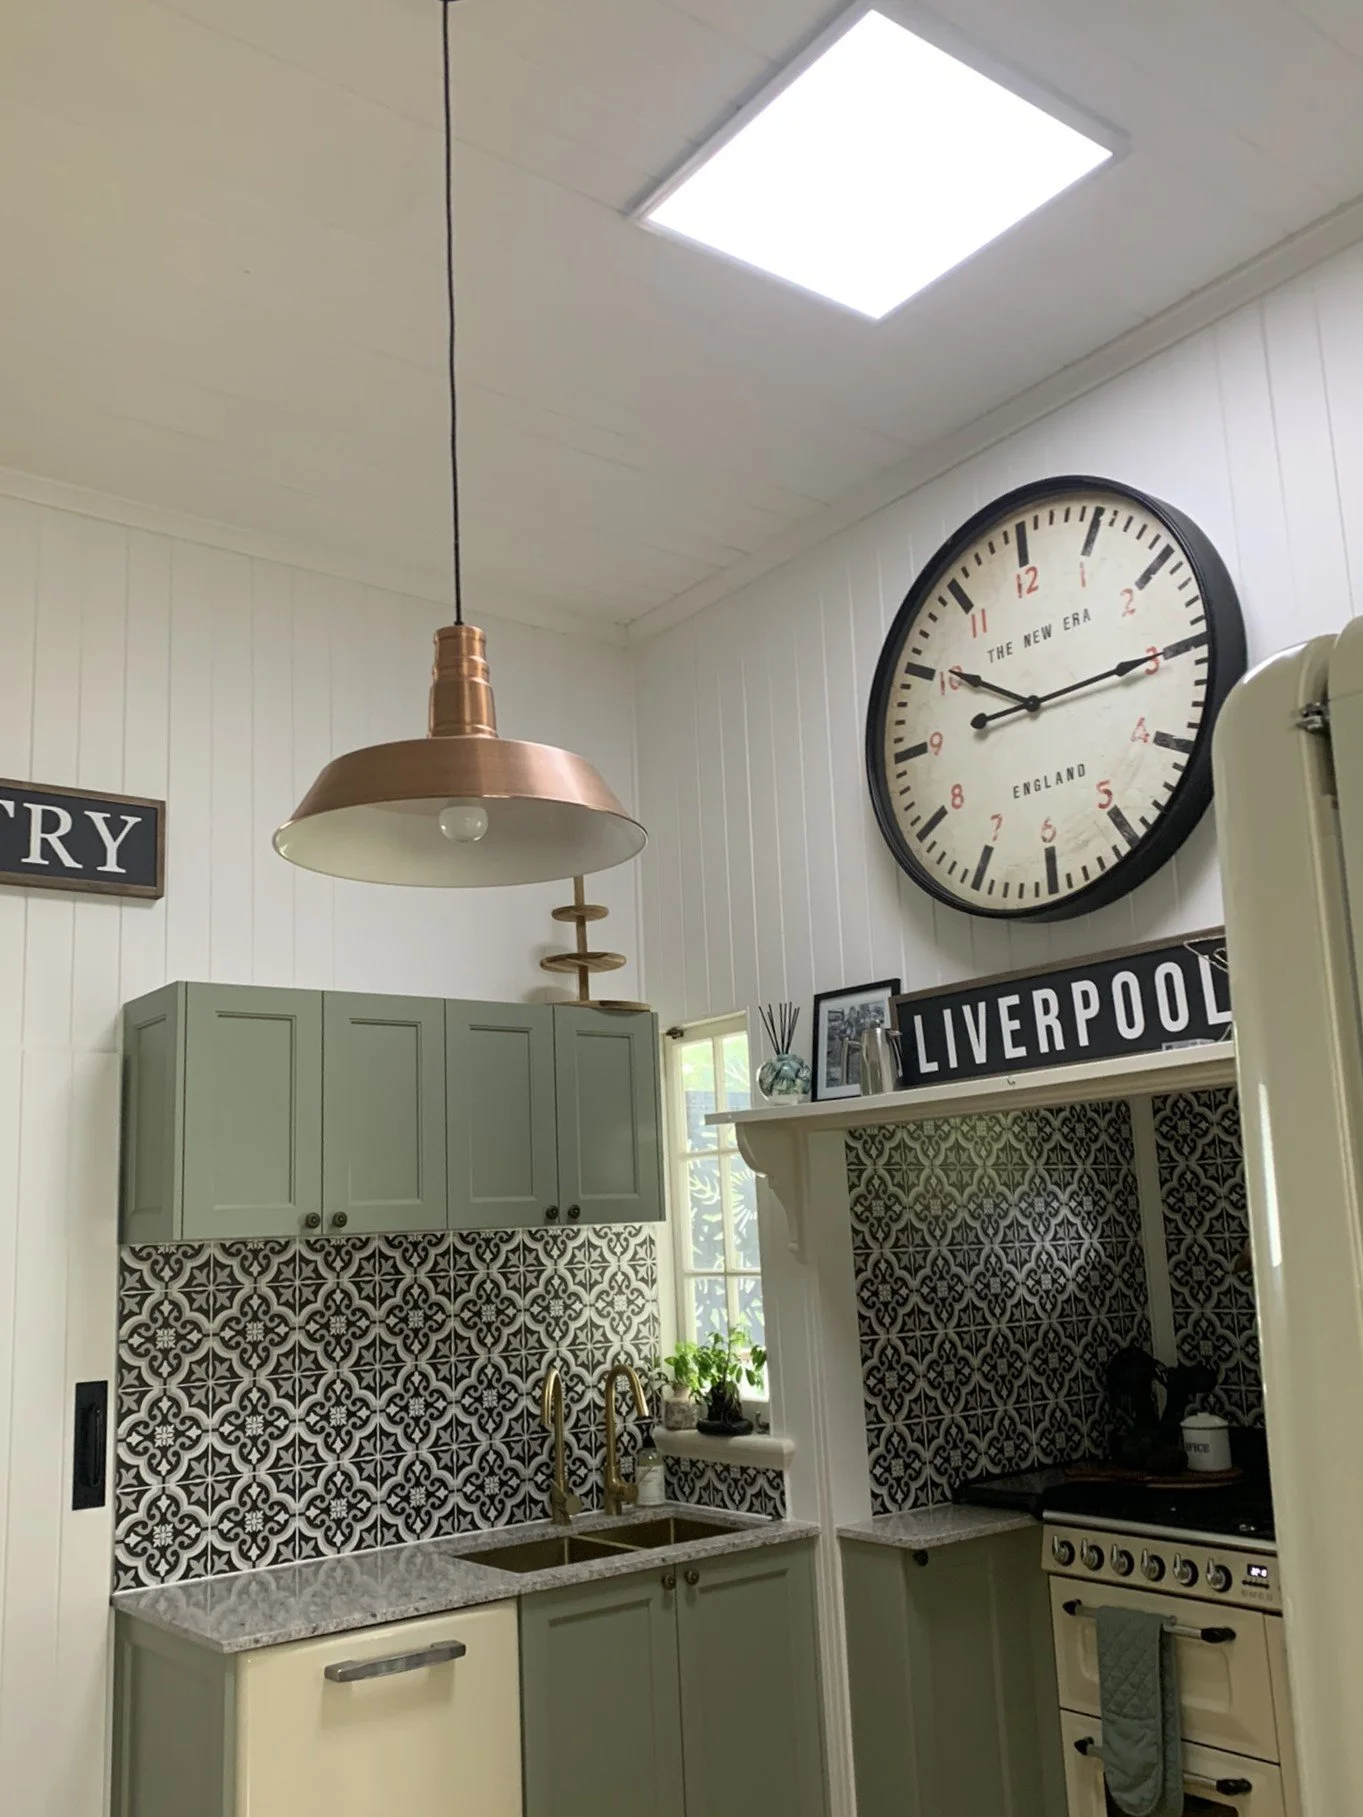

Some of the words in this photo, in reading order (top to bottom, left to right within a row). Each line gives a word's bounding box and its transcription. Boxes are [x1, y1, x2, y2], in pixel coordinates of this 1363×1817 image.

[1016, 566, 1039, 599] 12
[1079, 561, 1086, 588] 1
[1120, 588, 1136, 617] 2
[971, 608, 988, 638] 11
[987, 641, 1014, 663] THE
[1023, 623, 1052, 648] NEW
[1063, 608, 1091, 631] ERA
[1145, 646, 1159, 676] 3
[930, 732, 943, 756] 9
[1131, 717, 1150, 743] 4
[1013, 763, 1085, 799] ENGLAND
[1096, 779, 1113, 809] 5
[951, 783, 964, 809] 8
[991, 814, 1003, 841] 7
[1041, 816, 1056, 843] 6
[913, 953, 1231, 1073] LIVERPOOL
